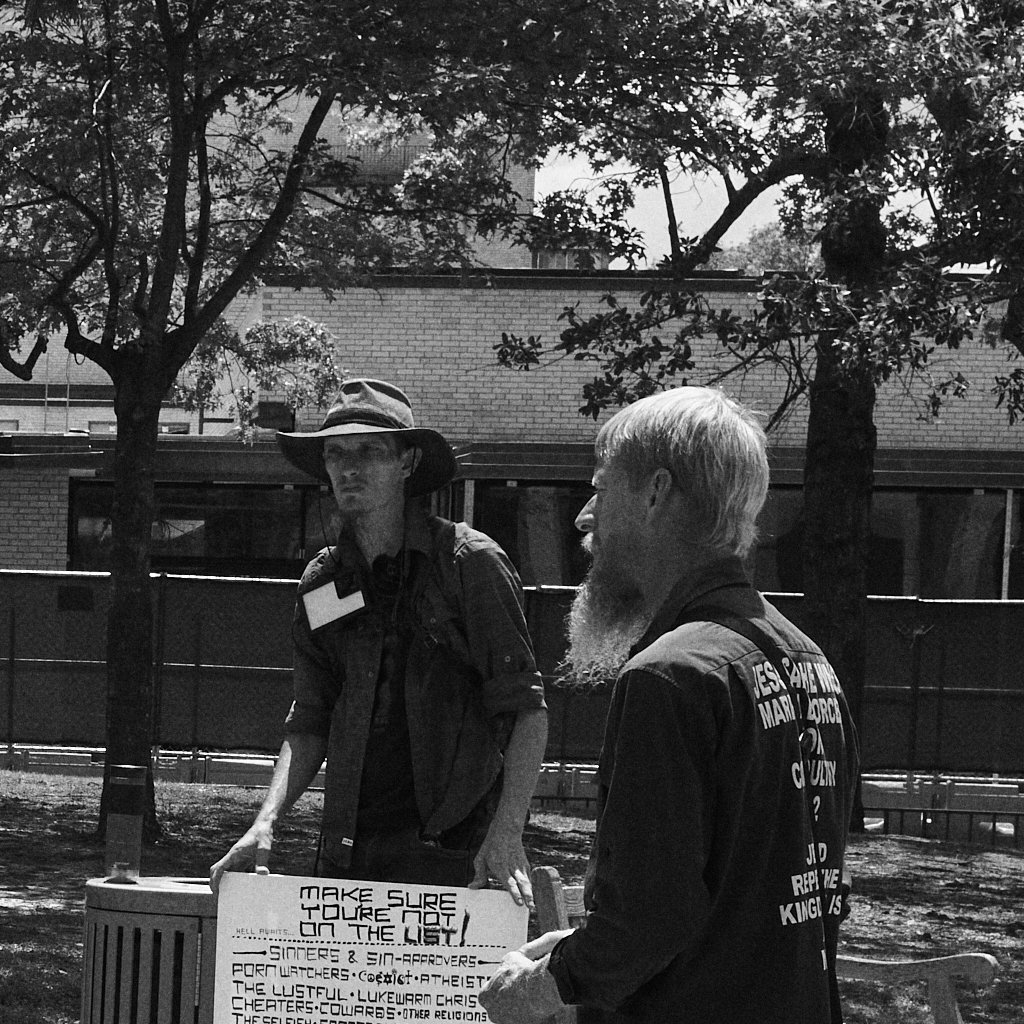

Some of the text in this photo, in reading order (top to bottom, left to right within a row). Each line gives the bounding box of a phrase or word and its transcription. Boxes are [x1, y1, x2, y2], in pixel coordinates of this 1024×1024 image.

[299, 885, 457, 911] MAKE SURE
[401, 909, 456, 927] NOT
[299, 920, 335, 938] ON
[347, 922, 396, 942] THE
[269, 945, 478, 968] SINNERS & SIN-APPROVERS
[232, 963, 277, 977] PORN
[279, 965, 350, 981] WATCHERS
[232, 980, 267, 996] THE
[272, 983, 348, 1002] LUSTFUL
[357, 988, 432, 1005] LUKEWARM
[231, 996, 314, 1014] CHEATERS
[402, 1007, 430, 1020] OTHER
[434, 1009, 488, 1022] RELIGIONS
